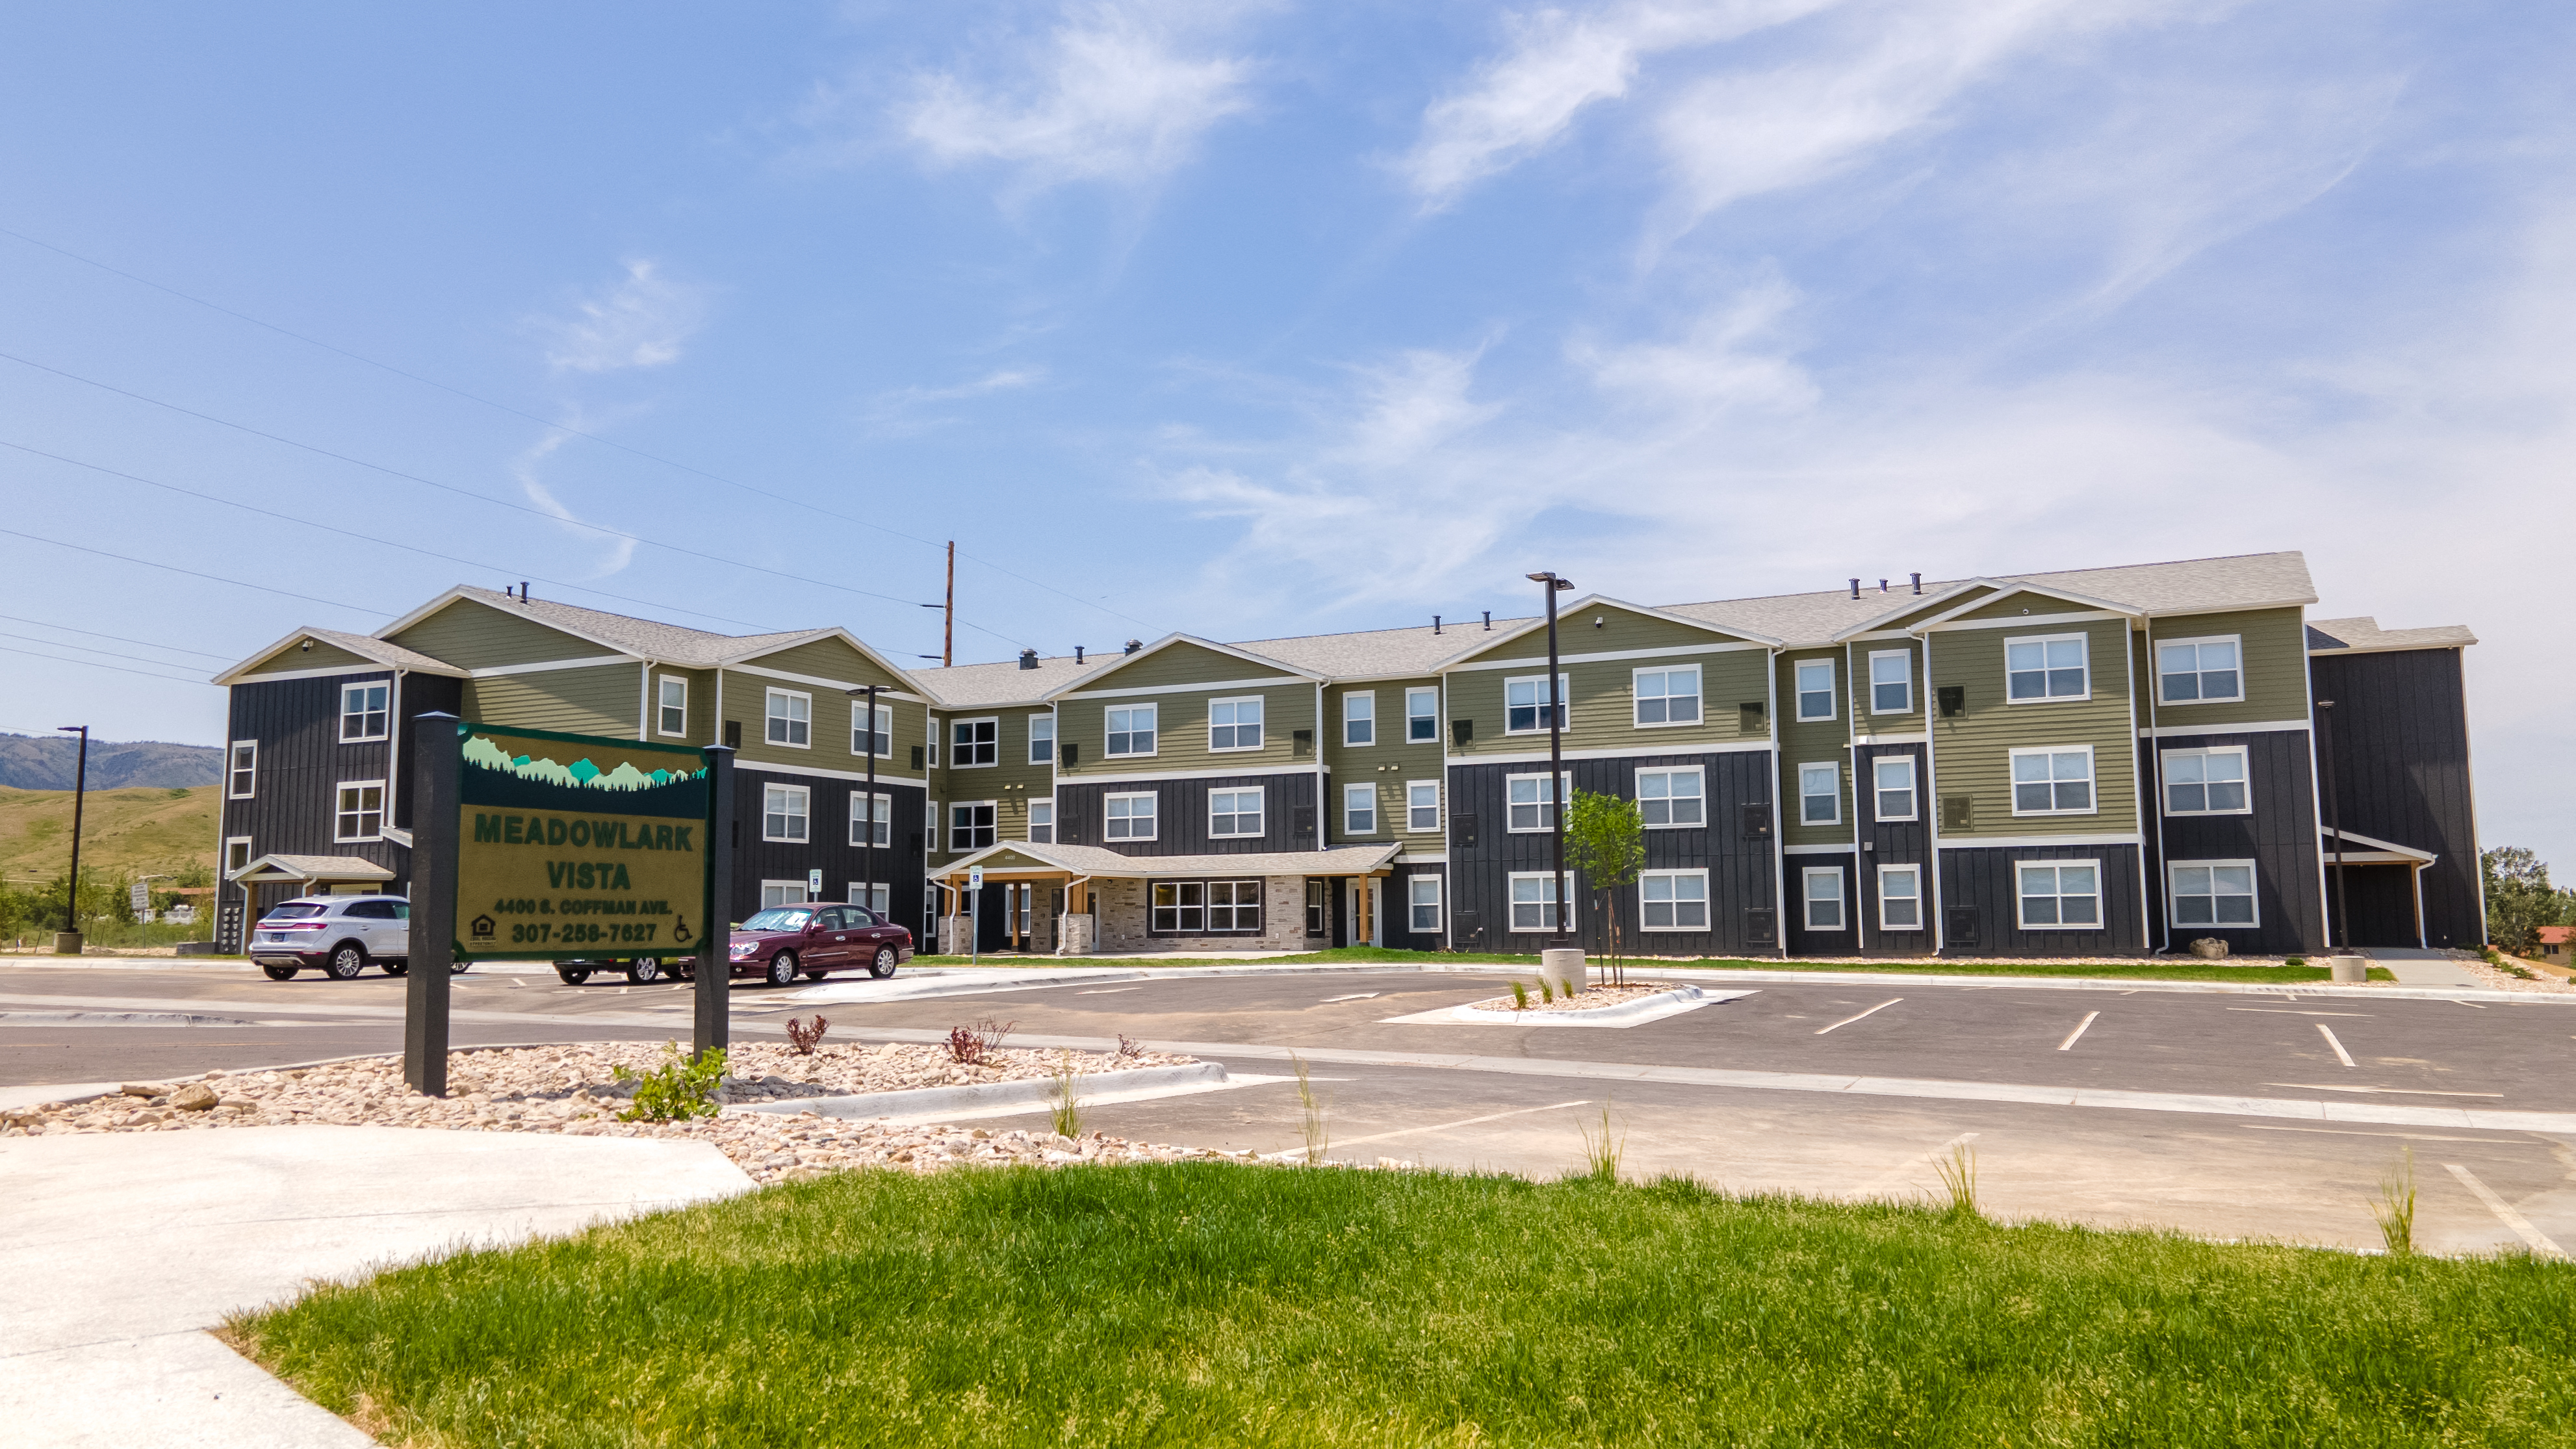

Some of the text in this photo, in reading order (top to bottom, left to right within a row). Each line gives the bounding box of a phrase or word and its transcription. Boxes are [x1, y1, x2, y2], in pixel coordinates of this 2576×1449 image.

[474, 813, 693, 852] MEADOWLARK
[547, 860, 632, 890] VISTA
[494, 899, 537, 914] 4400
[560, 900, 637, 915] COFFMAN
[639, 901, 673, 915] AVE.
[512, 923, 657, 943] 307-258-7627
